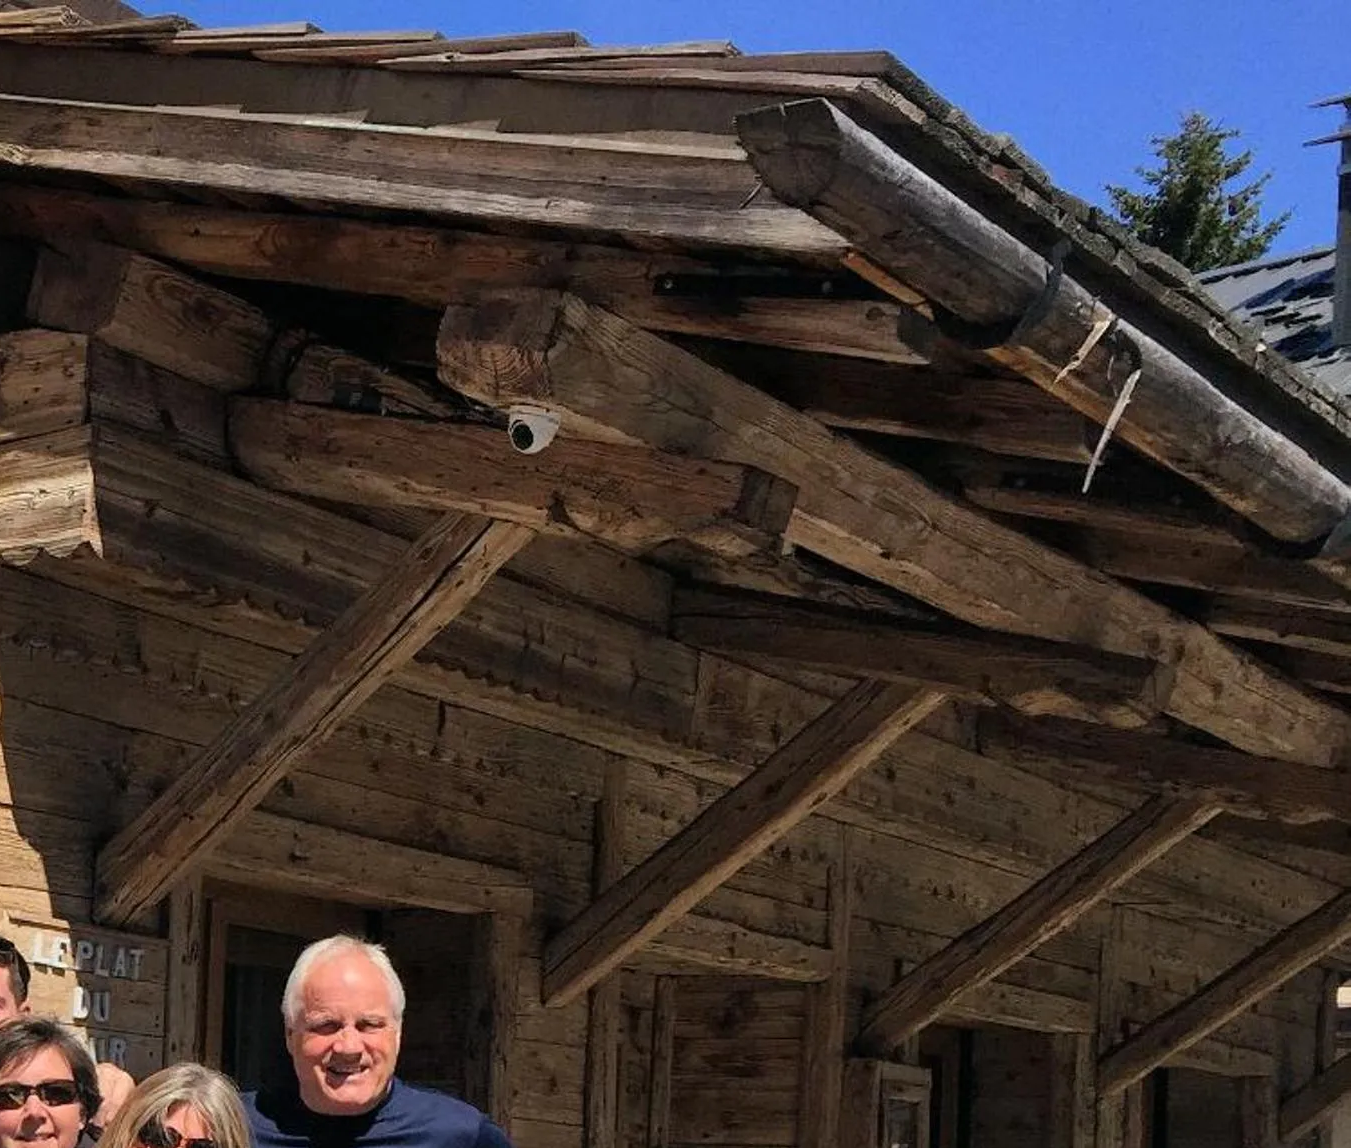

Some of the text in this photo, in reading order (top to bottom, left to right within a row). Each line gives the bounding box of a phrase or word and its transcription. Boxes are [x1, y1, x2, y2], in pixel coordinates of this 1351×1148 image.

[30, 930, 144, 980] LE PLAT
[73, 986, 109, 1022] DU
